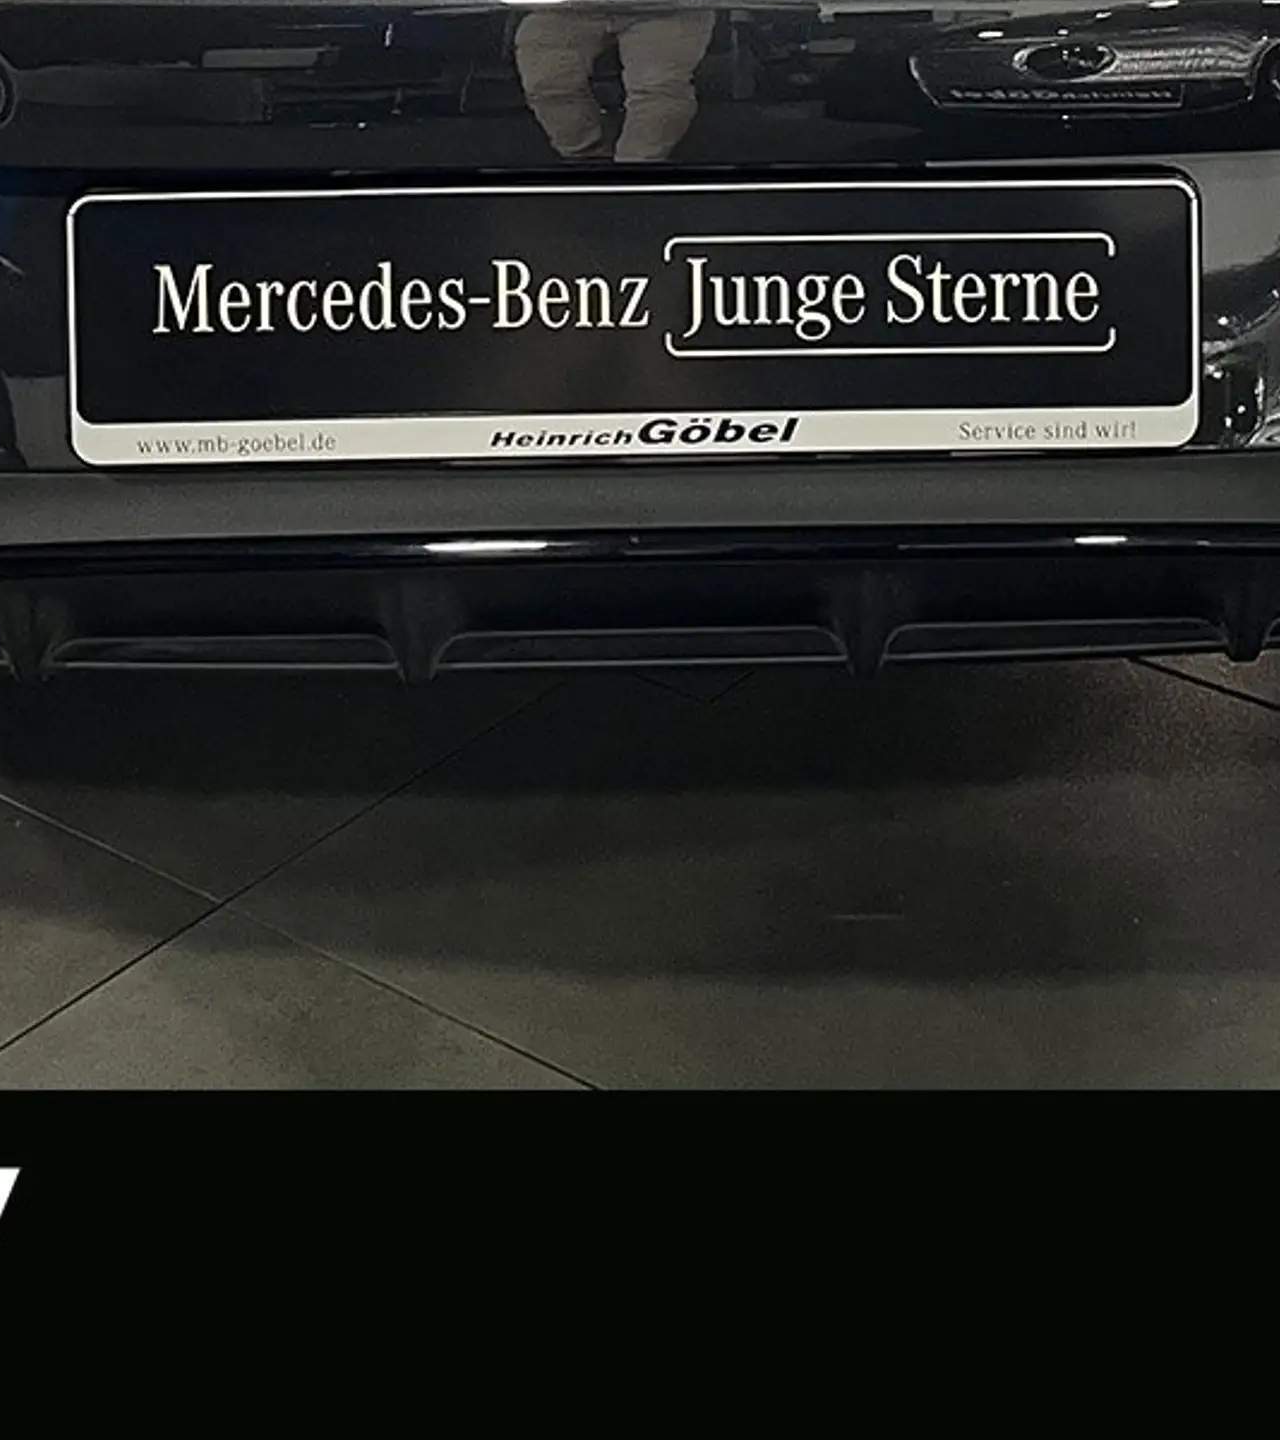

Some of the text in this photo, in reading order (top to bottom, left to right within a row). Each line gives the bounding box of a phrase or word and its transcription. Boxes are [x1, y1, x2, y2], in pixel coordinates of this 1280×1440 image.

[152, 253, 1100, 341] Mercedes-Benz Junge Sterne
[958, 419, 1137, 441] Service sind wir!
[135, 432, 337, 457] www.mb-goebel.de
